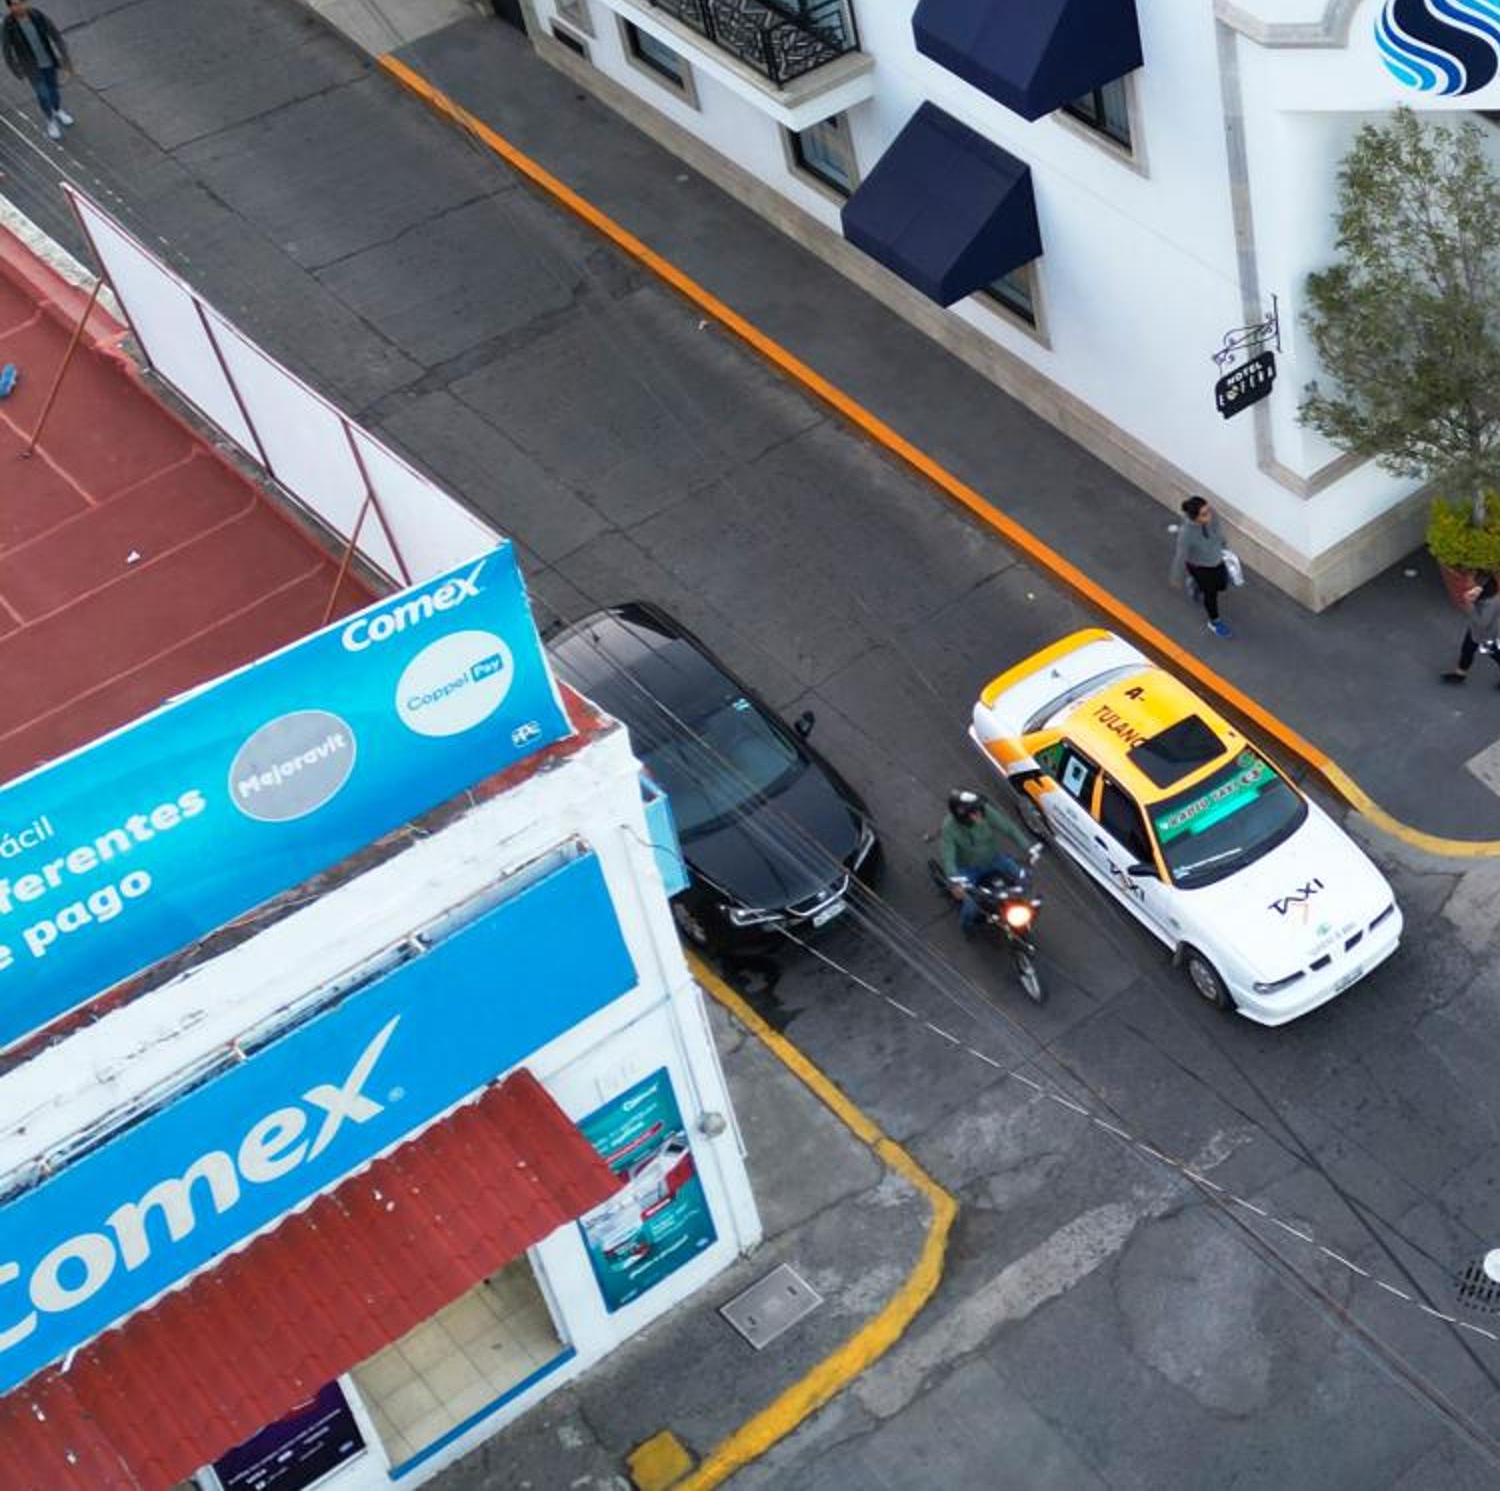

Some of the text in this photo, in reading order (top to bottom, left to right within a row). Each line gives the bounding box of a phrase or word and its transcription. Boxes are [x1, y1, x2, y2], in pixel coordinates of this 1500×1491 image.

[1227, 362, 1263, 387] HOTEL
[341, 559, 487, 652] Comex
[406, 672, 470, 712] Coppel
[237, 731, 347, 799] Mejoravit
[22, 870, 152, 958] pago
[1267, 877, 1325, 916] TAXI
